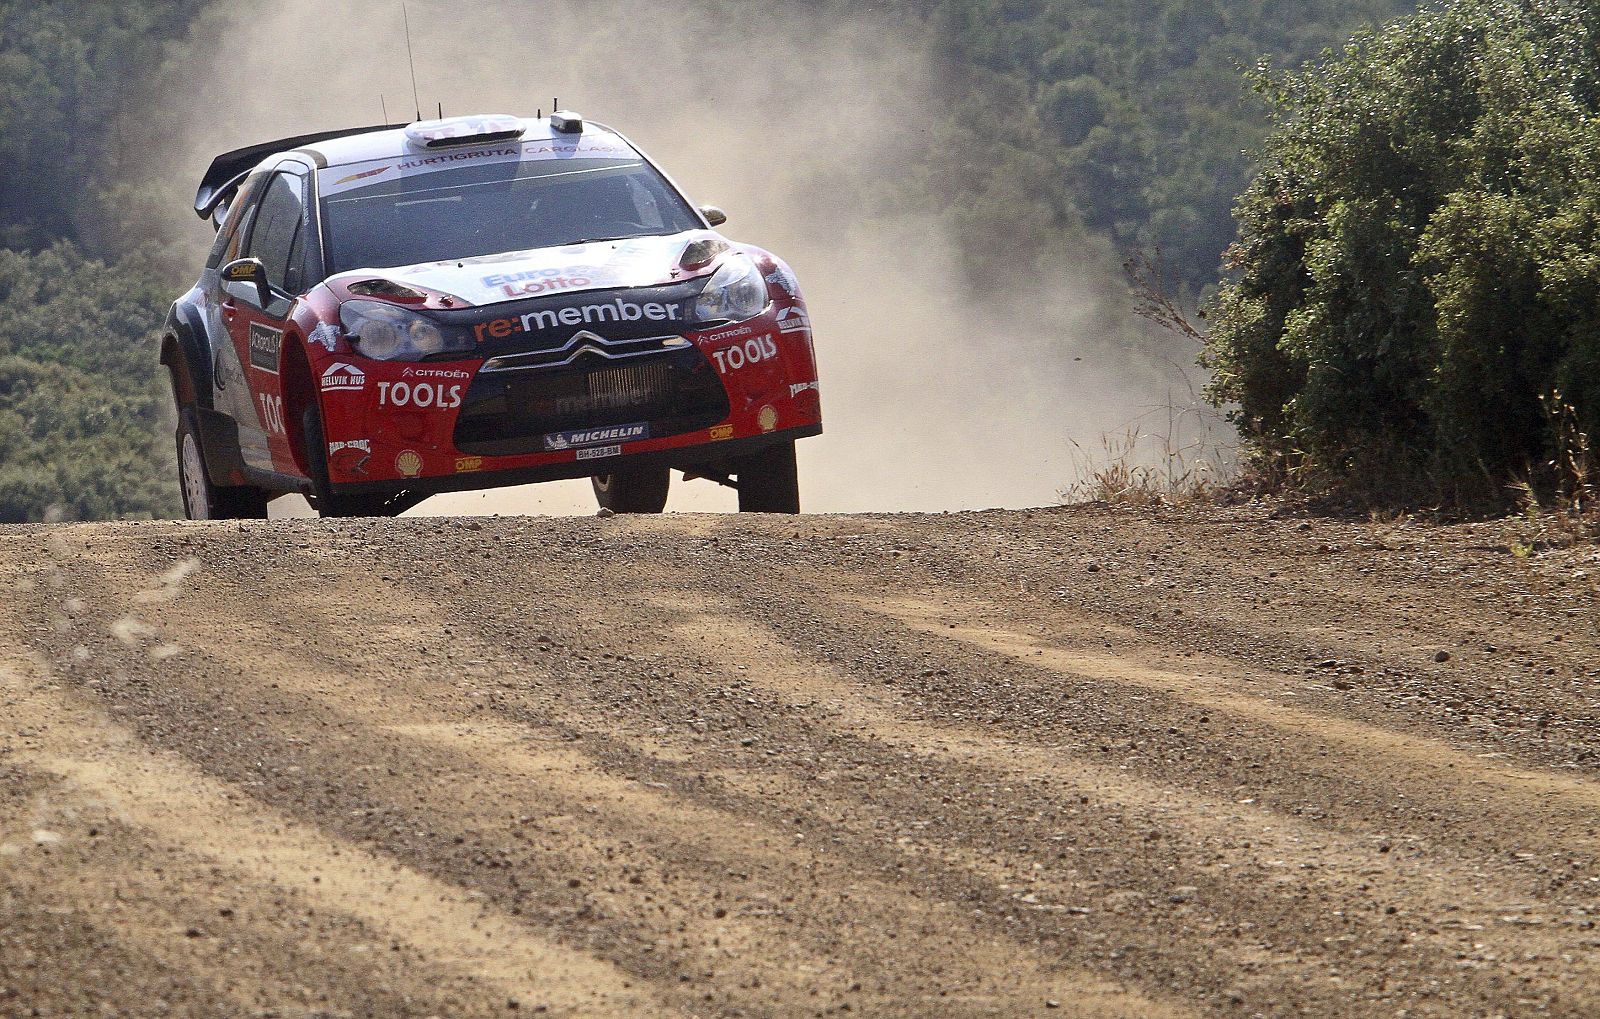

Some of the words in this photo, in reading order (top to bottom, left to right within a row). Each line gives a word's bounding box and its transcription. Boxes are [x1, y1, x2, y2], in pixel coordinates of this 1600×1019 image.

[396, 148, 518, 171] HURTIGRUTA
[231, 264, 256, 275] OMP
[481, 268, 561, 288] Euro
[503, 277, 591, 298] Lotto
[712, 333, 777, 374] TOOLS
[321, 376, 347, 387] HELLVIK
[350, 375, 365, 385] HUS
[377, 381, 461, 408] TOOLS
[570, 425, 644, 443] MICHELIN
[710, 427, 733, 439] OMP
[456, 459, 481, 470] OMP
